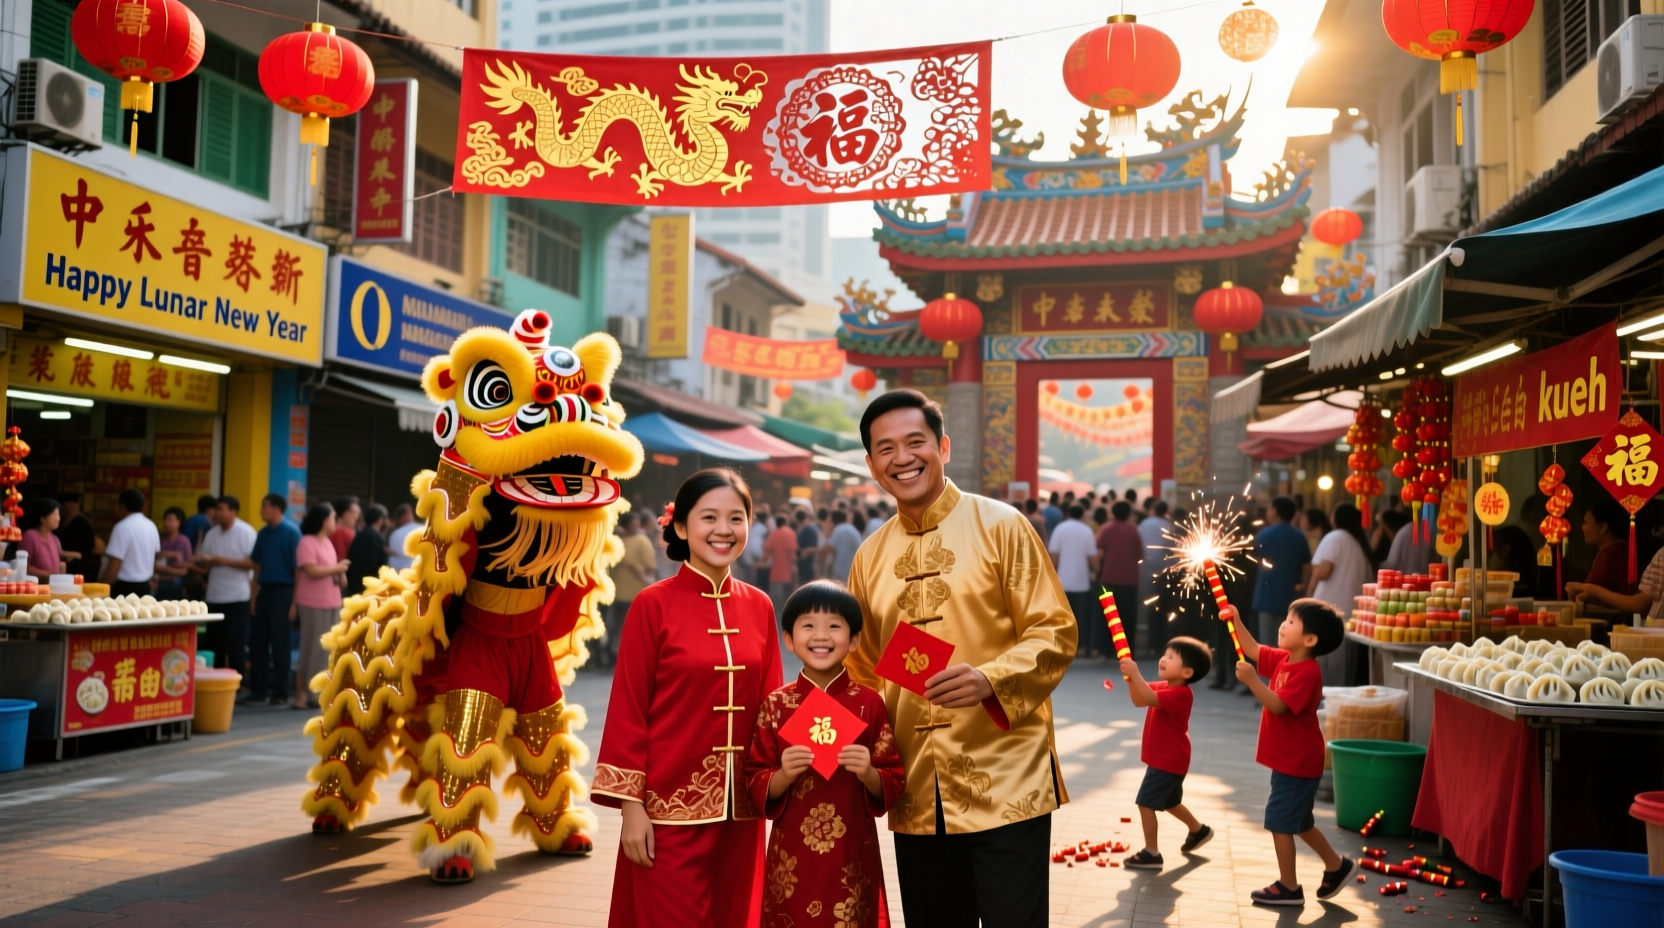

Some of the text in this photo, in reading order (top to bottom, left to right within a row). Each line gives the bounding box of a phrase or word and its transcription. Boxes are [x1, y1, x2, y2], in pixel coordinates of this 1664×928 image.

[799, 89, 880, 168] 福
[45, 252, 308, 343] Happy Lunar New Year
[1537, 355, 1607, 424] kueh
[1604, 433, 1659, 487] 福
[808, 716, 837, 745] 福
